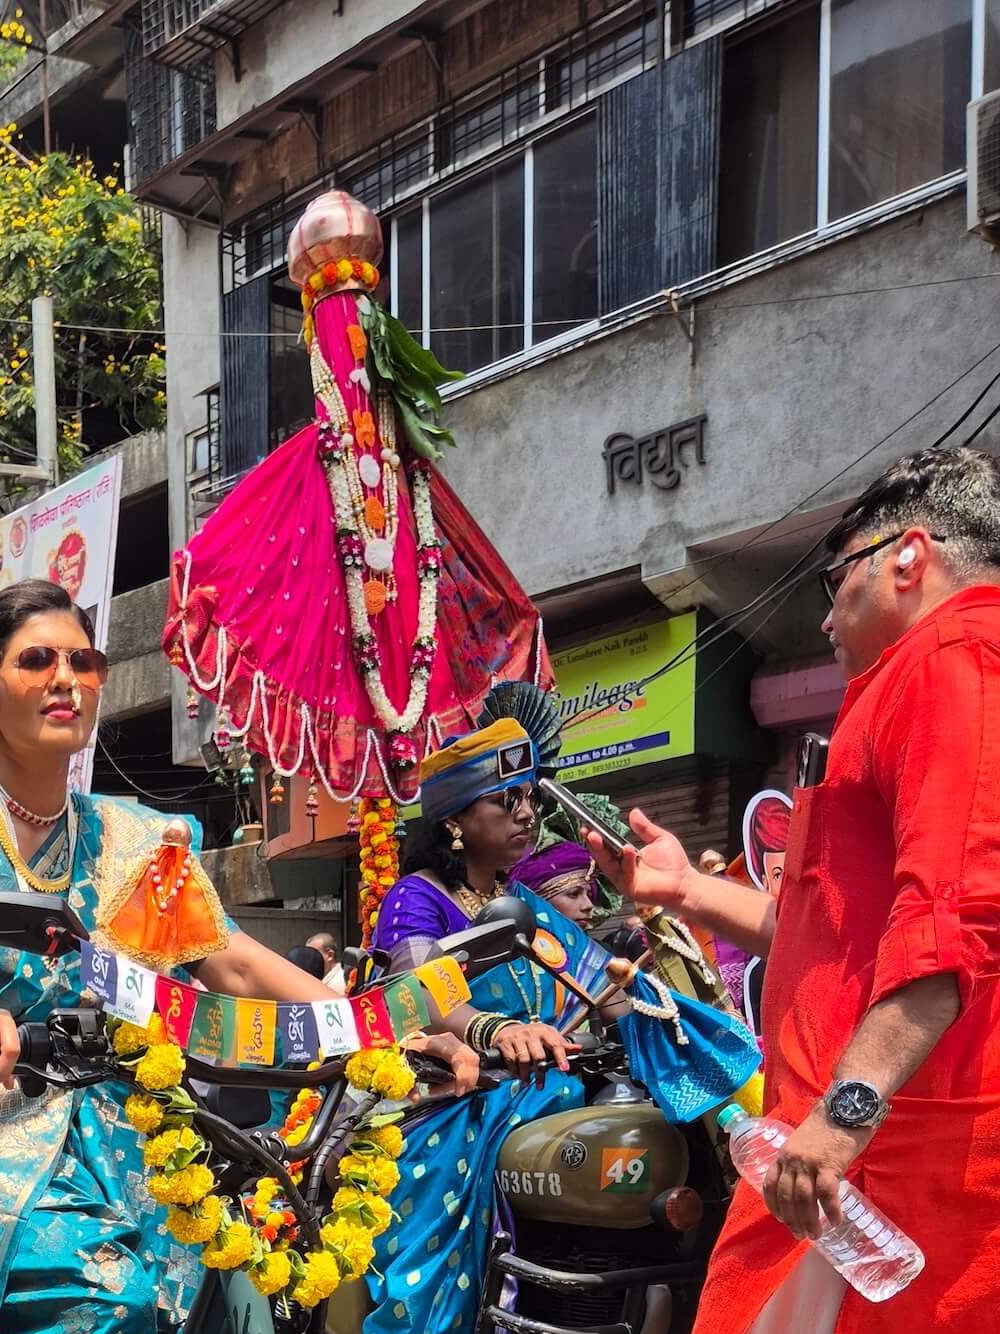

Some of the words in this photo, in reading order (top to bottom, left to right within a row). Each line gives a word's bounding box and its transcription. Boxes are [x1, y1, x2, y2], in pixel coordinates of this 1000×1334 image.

[601, 414, 708, 494] विद्युत
[551, 679, 646, 717] mileage
[592, 750, 601, 760] to
[605, 1158, 645, 1184] 49
